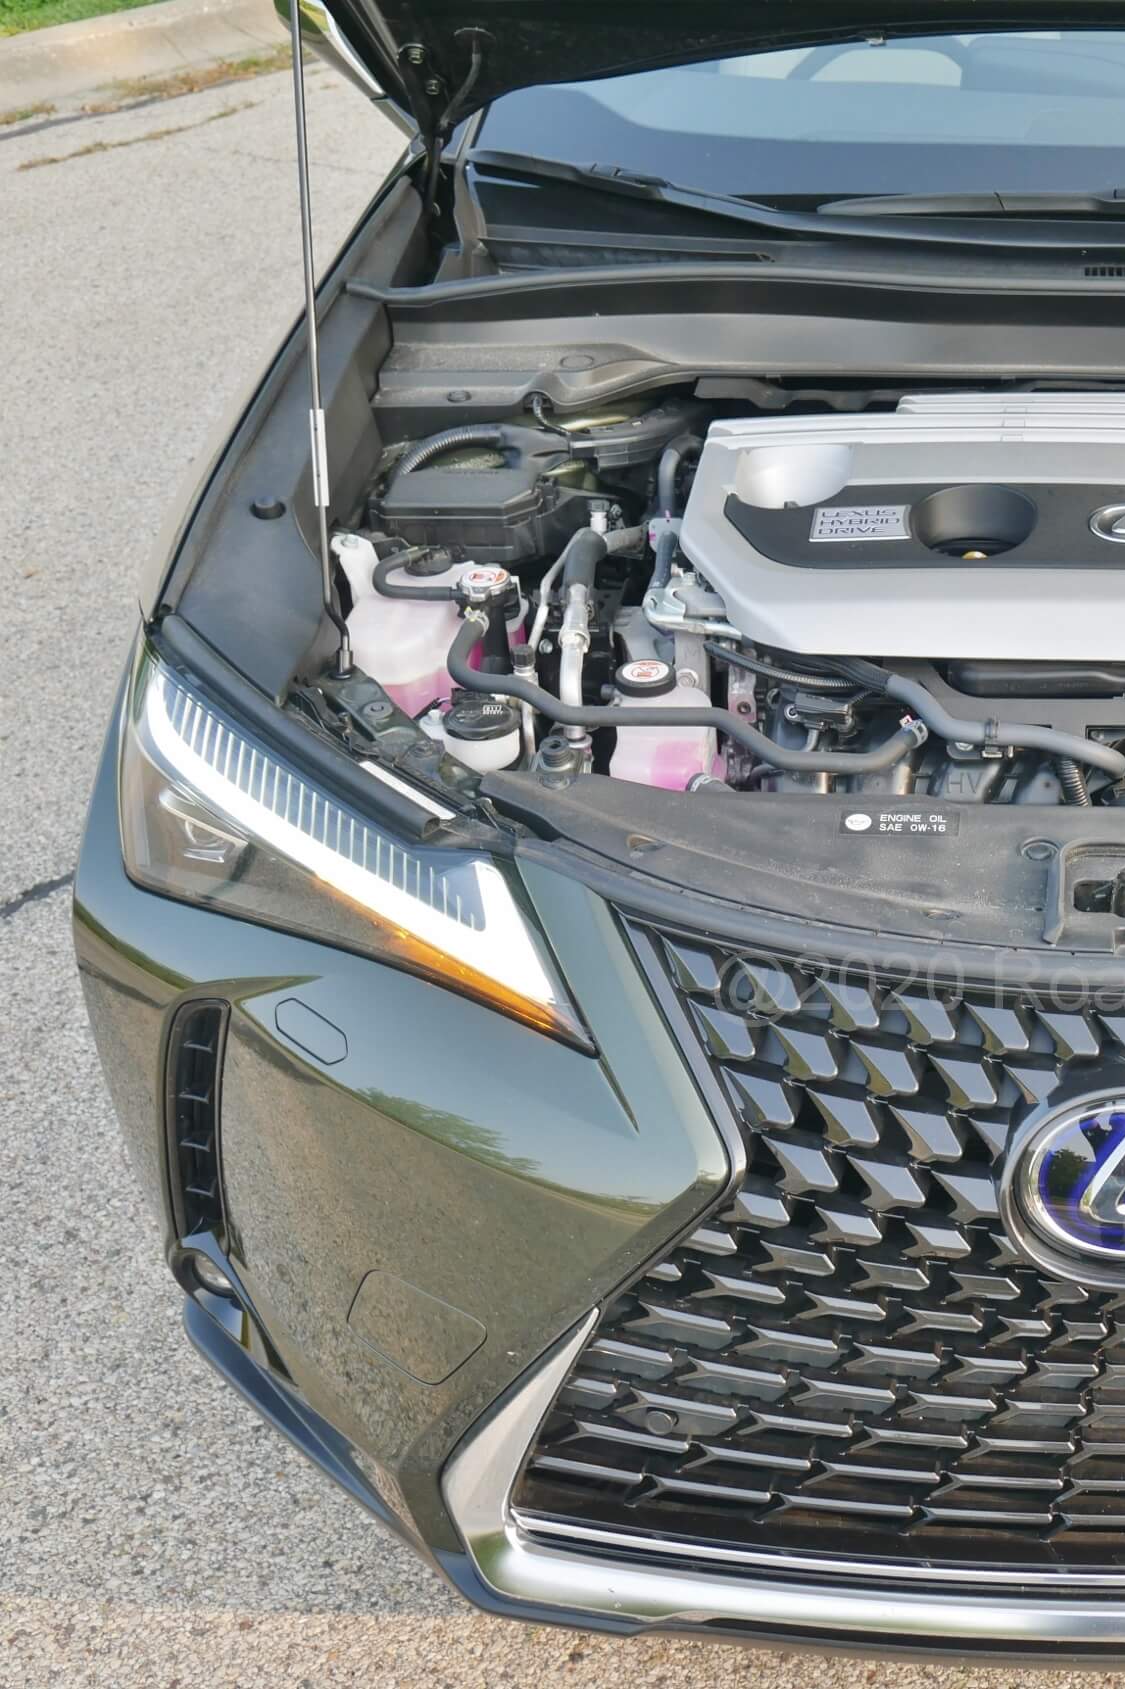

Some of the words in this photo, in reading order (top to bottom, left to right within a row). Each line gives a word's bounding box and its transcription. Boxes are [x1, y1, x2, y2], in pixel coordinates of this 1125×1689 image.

[820, 518, 901, 527] HYBRID
[818, 526, 887, 535] DRIVE
[879, 813, 922, 823] ENGINE
[929, 814, 948, 823] OIL
[879, 823, 904, 832] SAE
[910, 823, 947, 832] 0W-16
